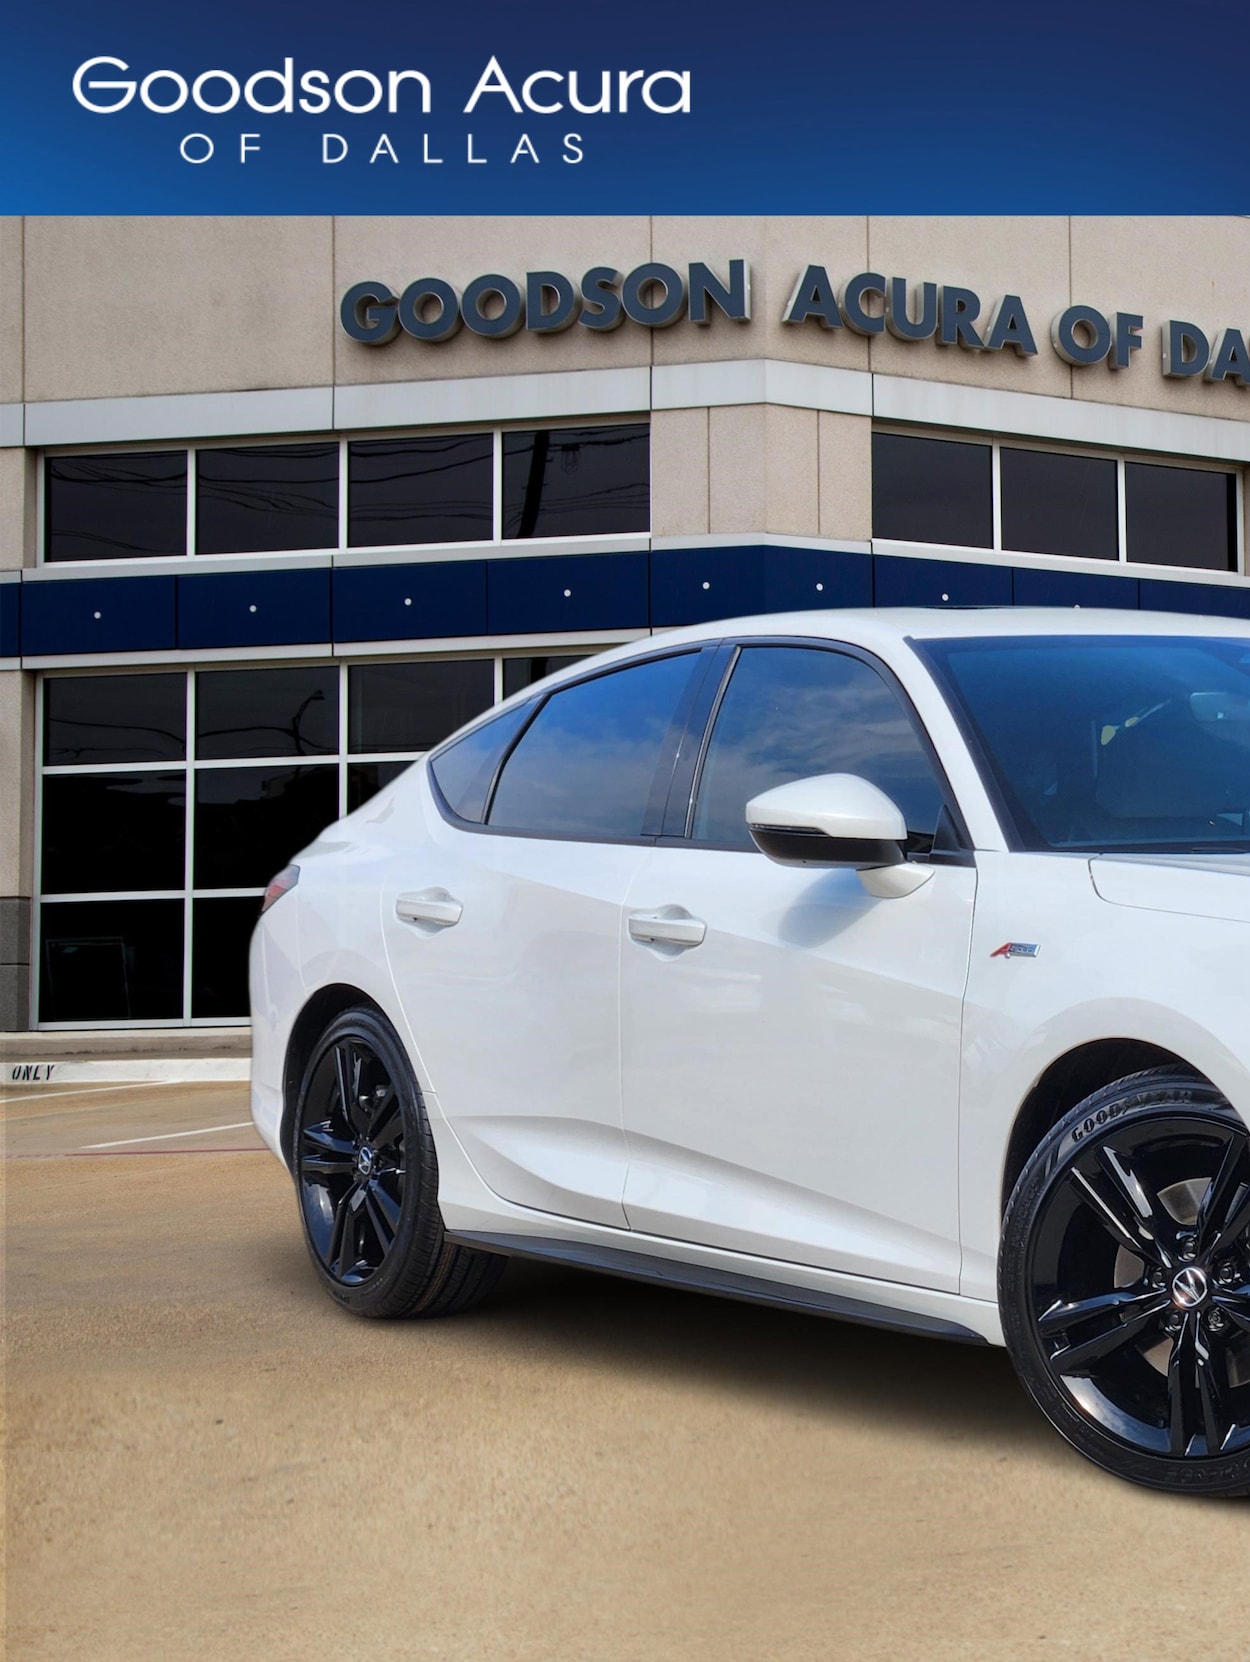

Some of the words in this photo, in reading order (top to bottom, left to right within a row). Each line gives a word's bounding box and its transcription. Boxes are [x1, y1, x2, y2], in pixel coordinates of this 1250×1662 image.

[340, 259, 751, 345] GOODSON
[782, 264, 1038, 357] ACURA
[1051, 305, 1144, 370] OF
[12, 1064, 55, 1081] ONLY
